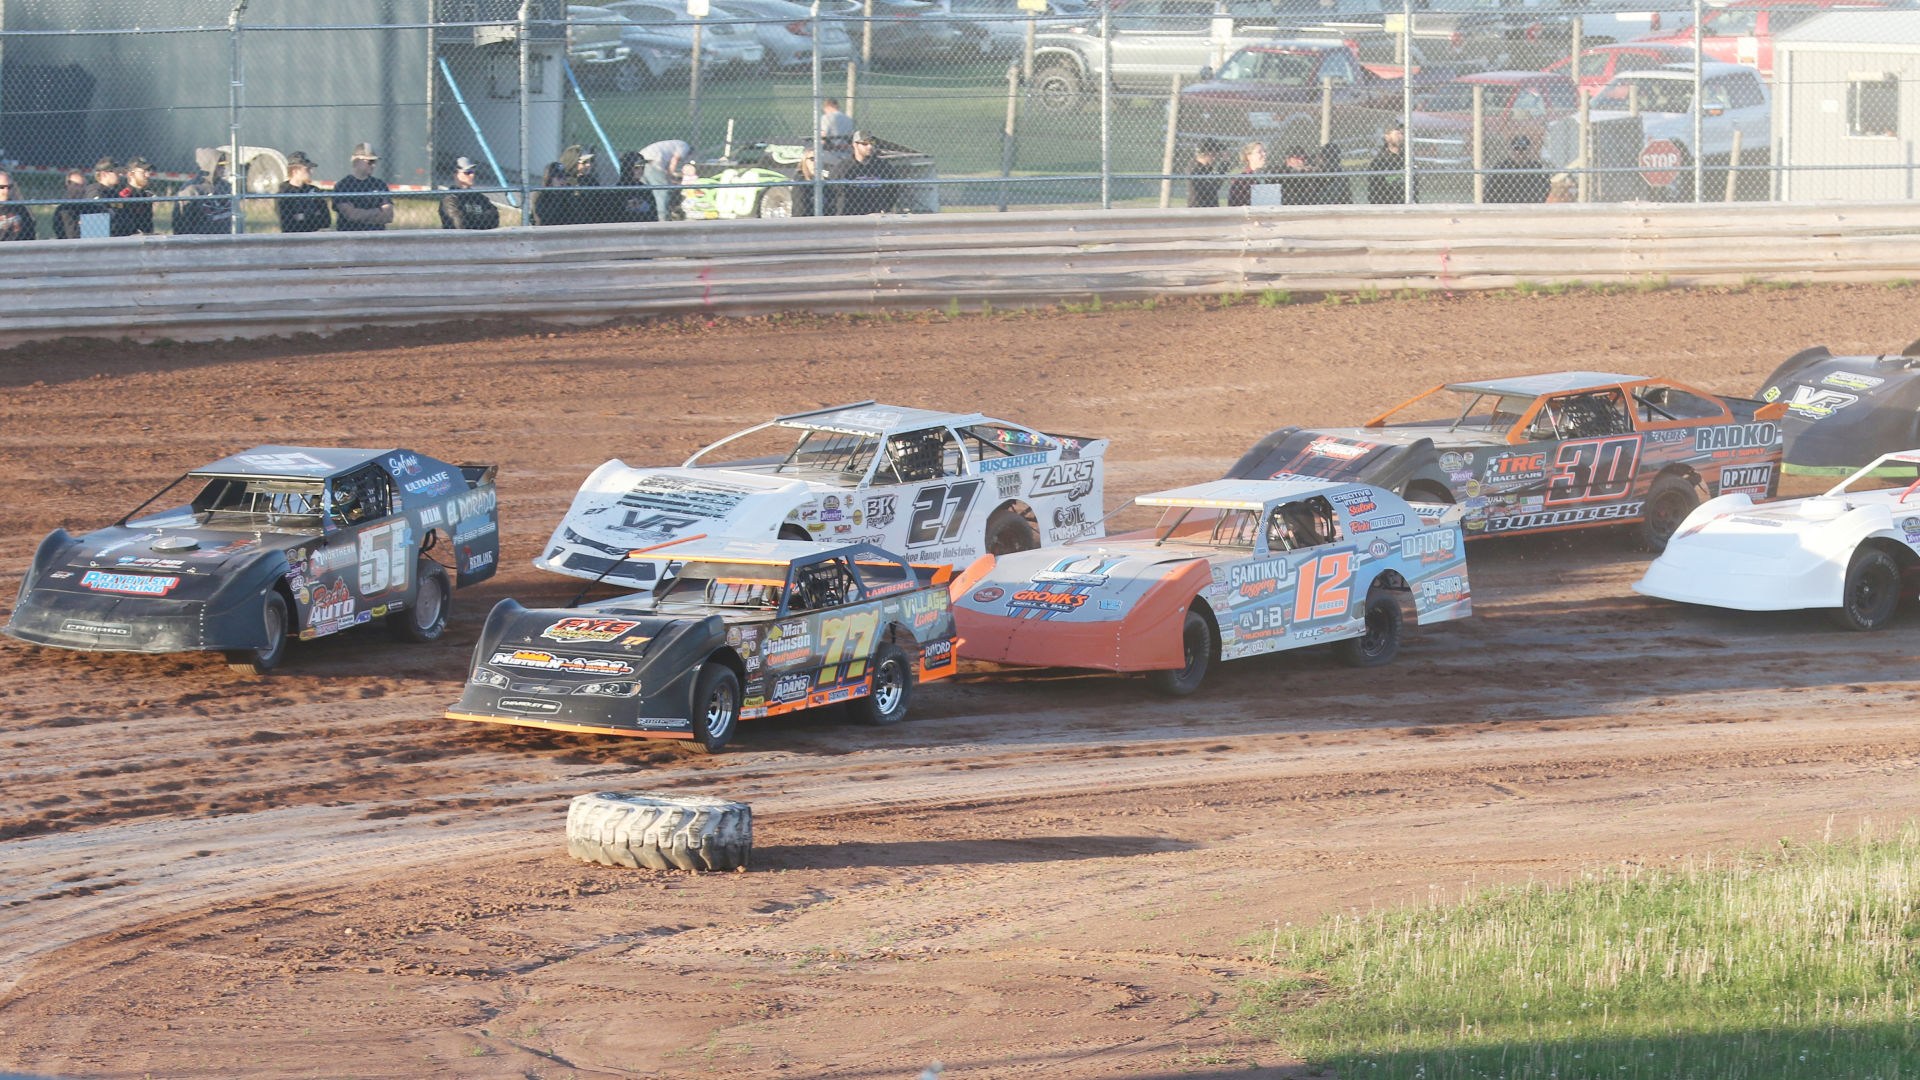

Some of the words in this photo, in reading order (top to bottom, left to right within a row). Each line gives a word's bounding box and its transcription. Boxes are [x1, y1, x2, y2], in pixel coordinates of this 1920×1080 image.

[1642, 152, 1678, 168] STOP
[1695, 422, 1776, 452] RADKO
[1498, 454, 1545, 474] TRC
[1544, 434, 1642, 506] 30
[404, 471, 449, 493] ULTIMATE
[1492, 474, 1518, 483] RACE
[1520, 471, 1542, 481] CARS
[1722, 466, 1770, 488] OPTIMA
[905, 478, 985, 549] 27
[1486, 502, 1645, 531] BURDICK
[1401, 528, 1455, 558] DAN'S
[357, 519, 406, 598] 51
[81, 571, 178, 587] PRZYBYLSKI
[1231, 559, 1287, 588] SANTIKKO
[90, 582, 167, 594] TRUCKING
[865, 580, 915, 598] LAWRENCE
[1239, 578, 1277, 598] Logging
[1294, 550, 1354, 623] 12
[1012, 590, 1089, 607] GRONK'S
[308, 598, 355, 625] AUTO
[66, 623, 130, 635] CAMARO
[553, 618, 636, 634] FYE
[782, 620, 808, 638] Mark
[763, 634, 812, 656] Johnson
[817, 609, 880, 685] 77
[775, 678, 808, 702] ADAMS
